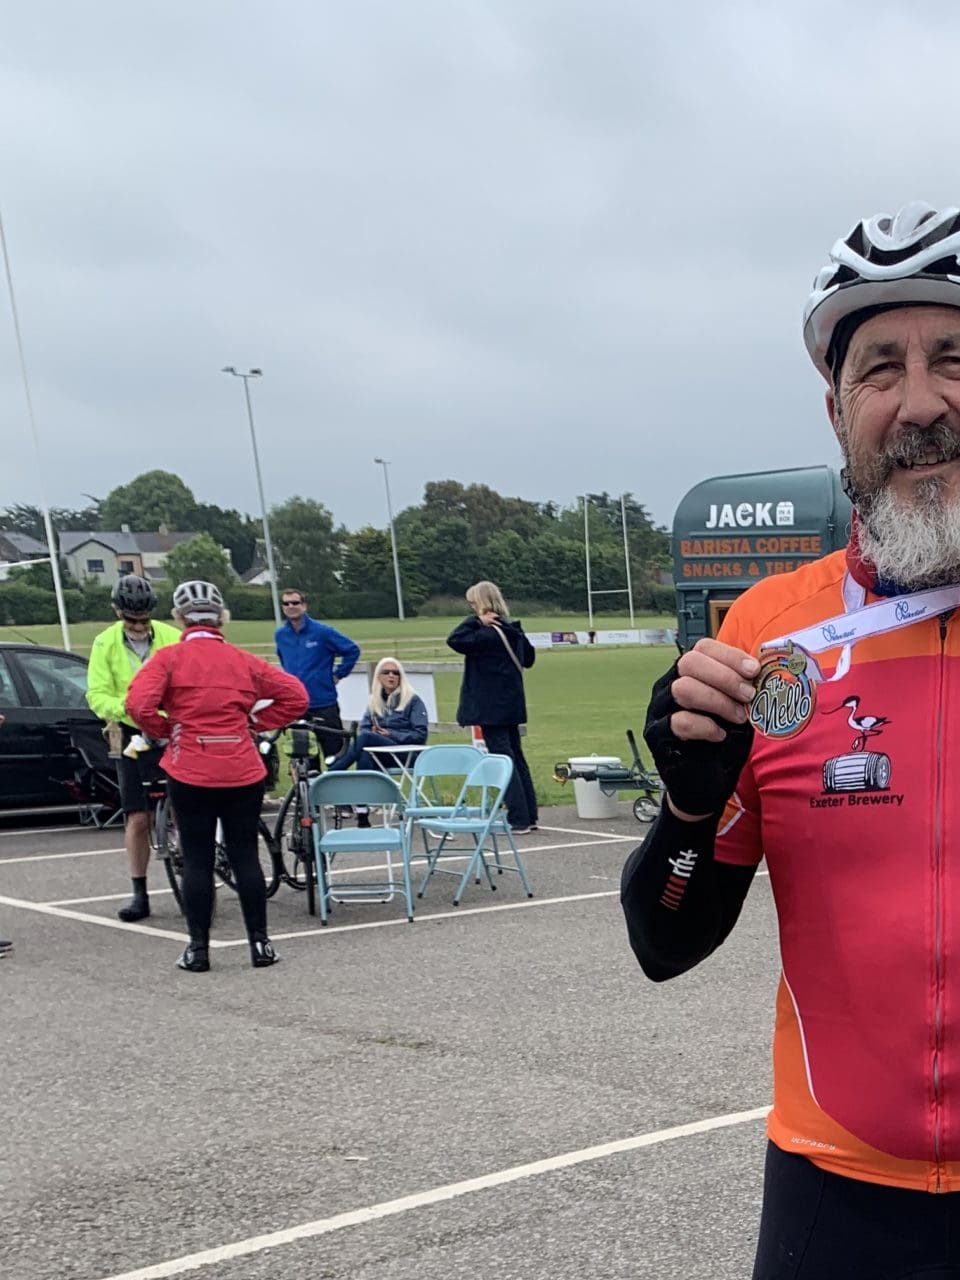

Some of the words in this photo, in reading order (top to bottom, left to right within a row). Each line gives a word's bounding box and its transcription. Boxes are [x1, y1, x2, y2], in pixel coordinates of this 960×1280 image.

[706, 502, 774, 528] JACK
[680, 538, 750, 556] BARISTA
[756, 536, 821, 553] COFFEE
[682, 561, 742, 577] SNACKS
[748, 562, 760, 576] &
[750, 682, 811, 735] Nello
[809, 796, 844, 809] Exeter
[848, 794, 904, 806] Brewery
